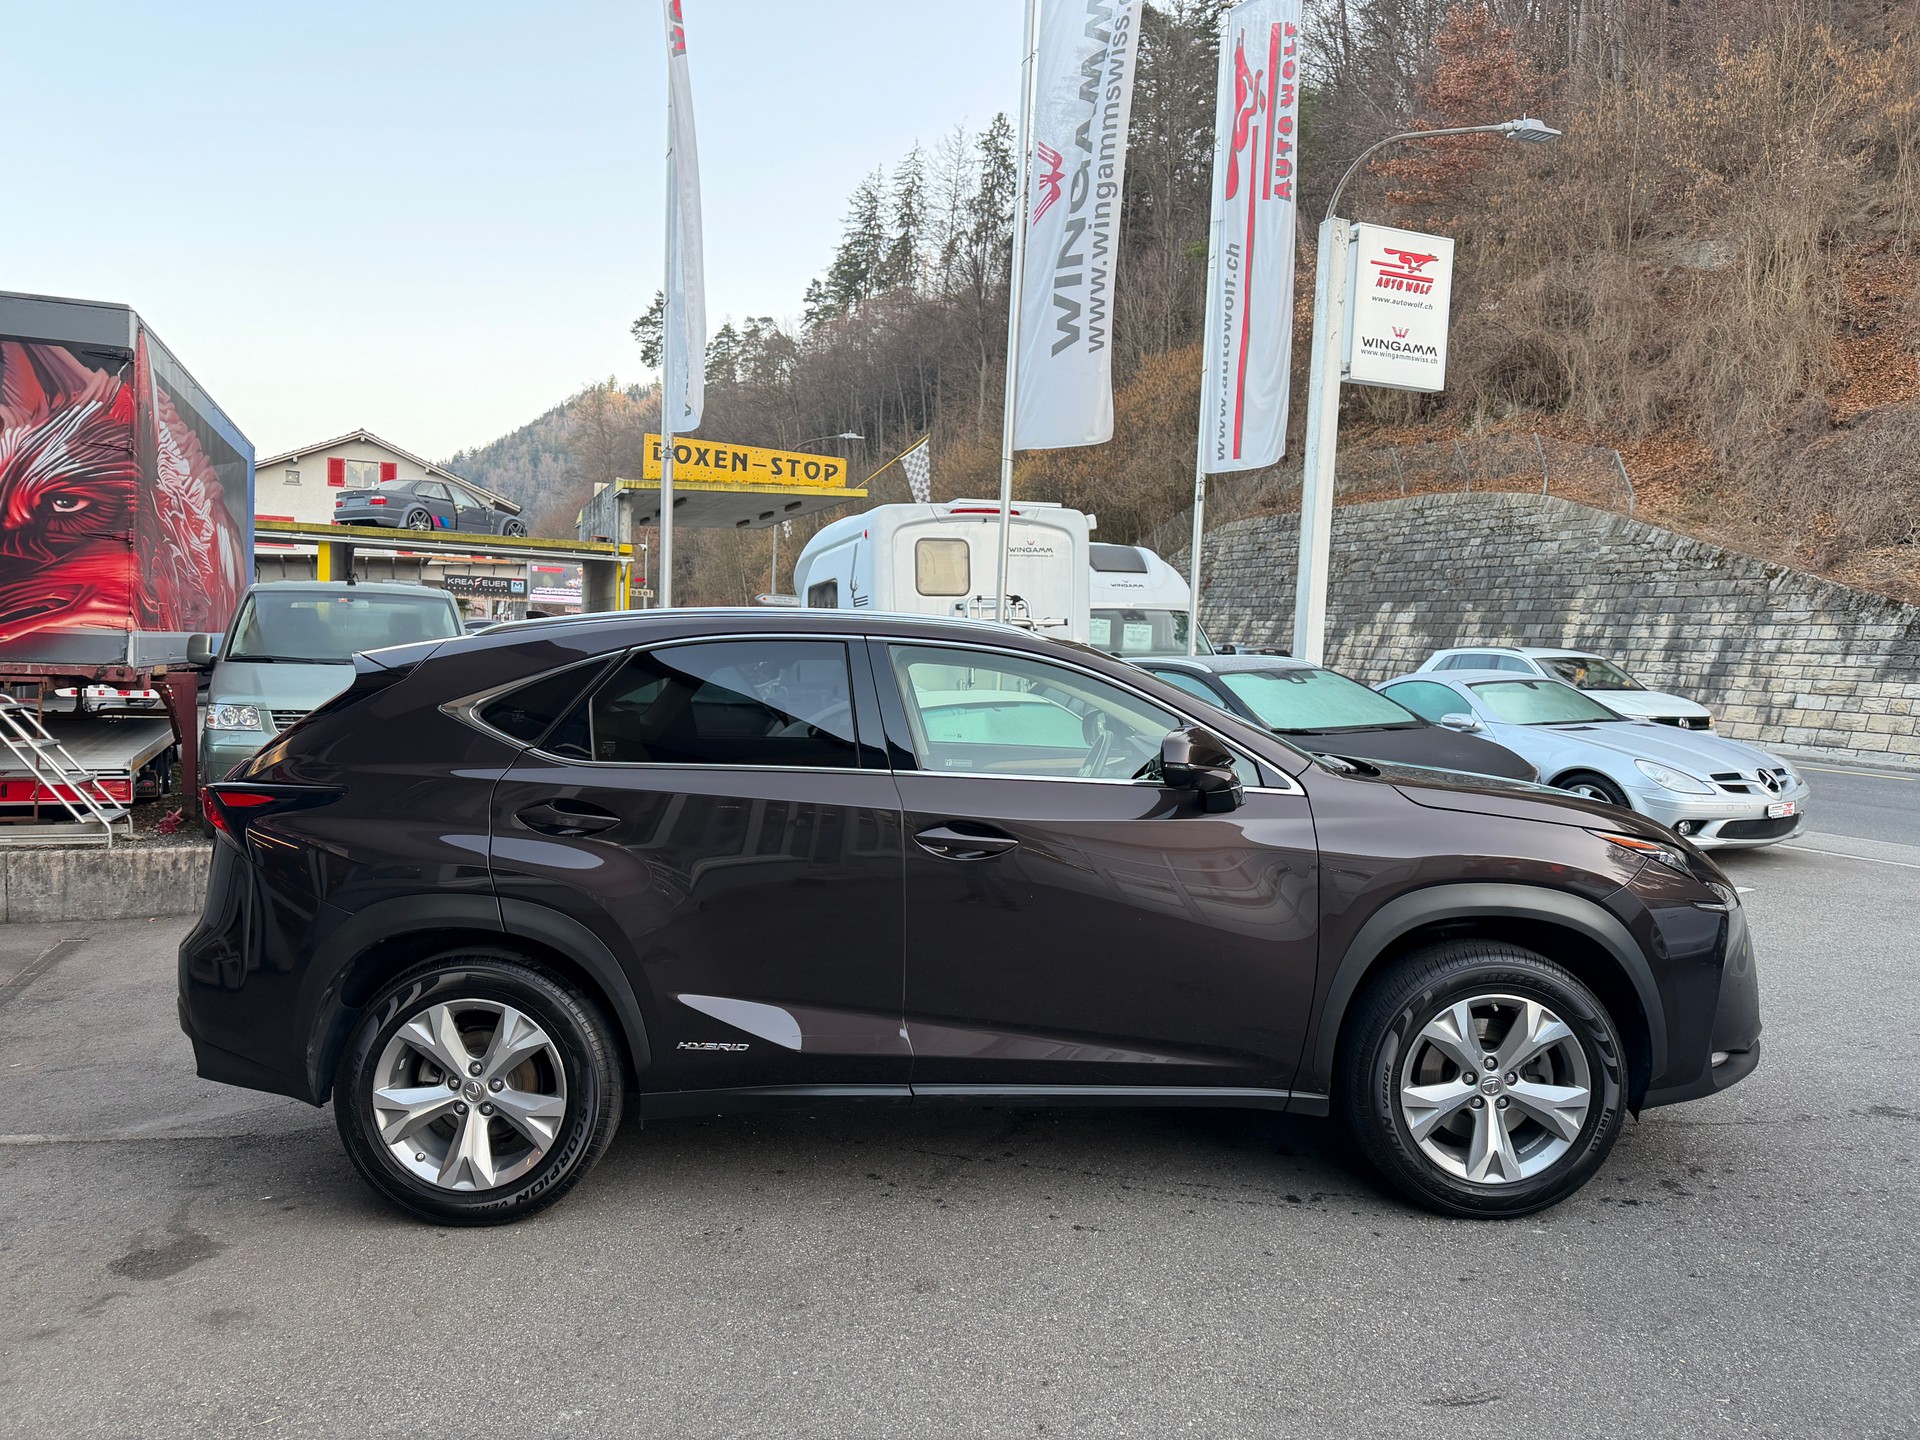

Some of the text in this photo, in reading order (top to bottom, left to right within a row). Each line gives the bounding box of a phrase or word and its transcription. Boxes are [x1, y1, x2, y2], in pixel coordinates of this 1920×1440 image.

[1274, 21, 1298, 202] AUTO WOLF
[1052, 0, 1112, 358] WINGAMM
[1375, 276, 1433, 295] AUTO WOLF
[1371, 295, 1434, 311] www.autowolf.ch
[1360, 348, 1438, 365] www.wingammswiss.ch
[1362, 336, 1438, 357] WINGAMM
[676, 1041, 749, 1051] HYBRID
[1382, 1062, 1391, 1110] VERDE
[515, 1105, 588, 1205] SCORPION
